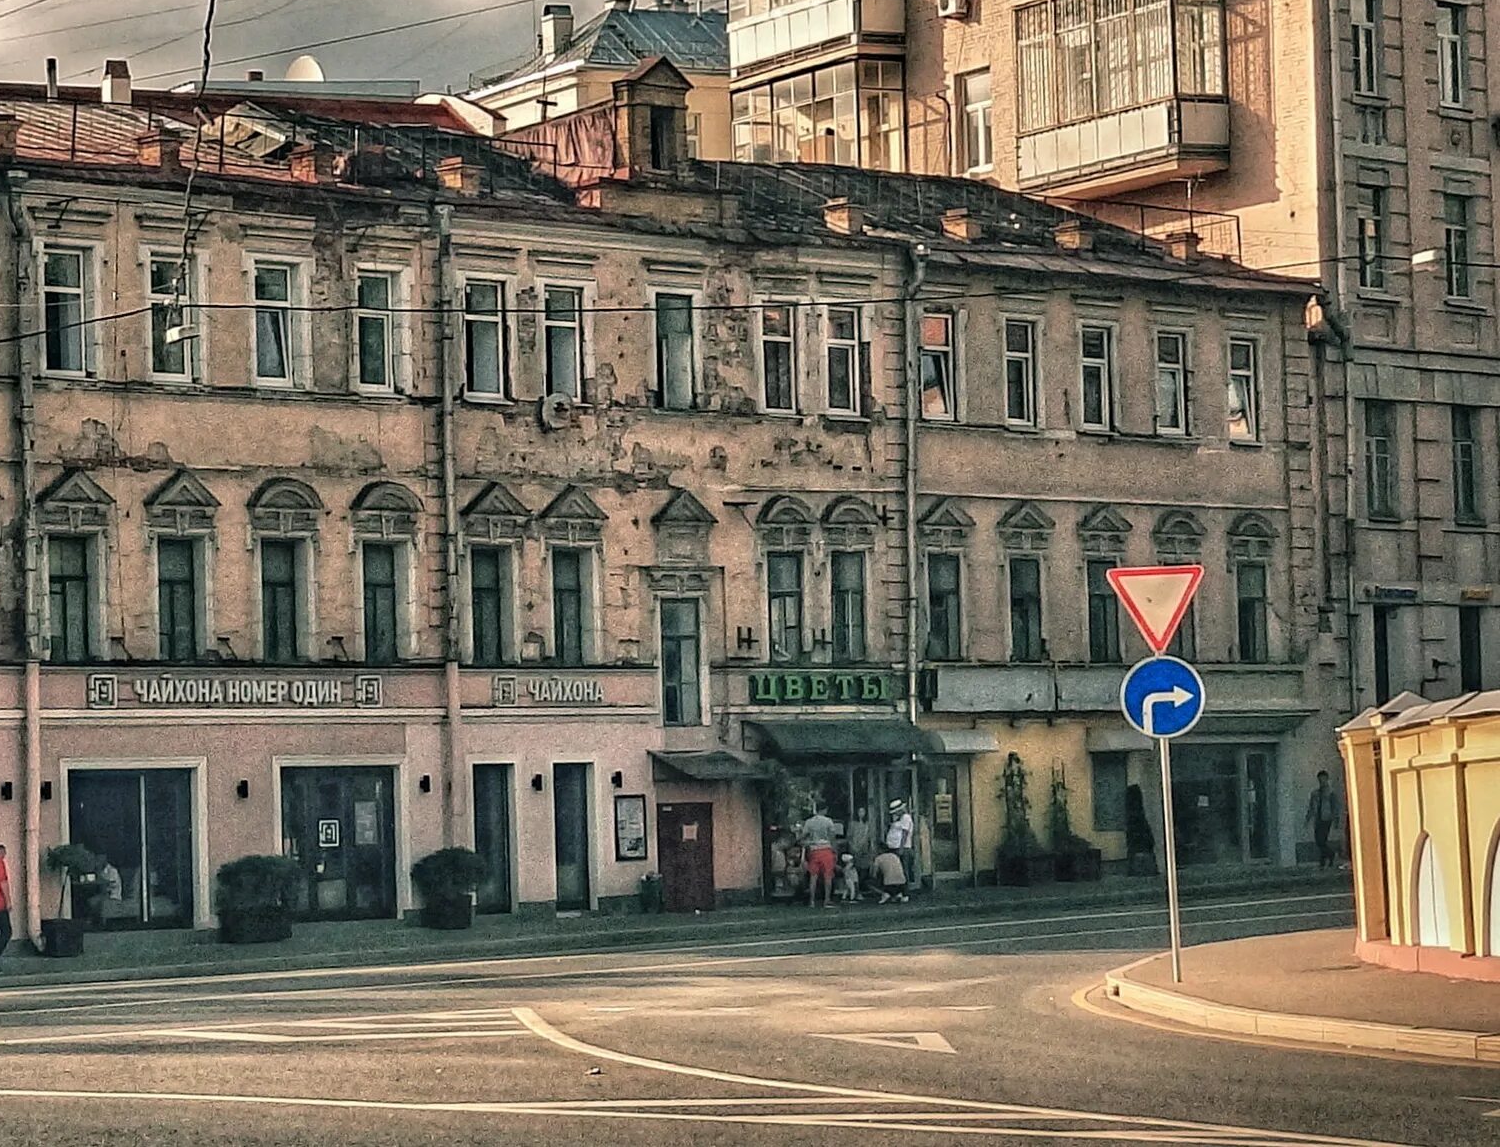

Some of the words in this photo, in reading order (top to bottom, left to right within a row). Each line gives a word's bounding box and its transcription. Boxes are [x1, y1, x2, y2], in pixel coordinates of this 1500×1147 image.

[134, 673, 222, 703] ЧАЙХОНА
[228, 680, 288, 703] НОМЕР
[292, 680, 342, 706] ОДИН
[529, 675, 604, 701] ЧАЙХОНА
[755, 674, 890, 704] ЦВЕТЫ
